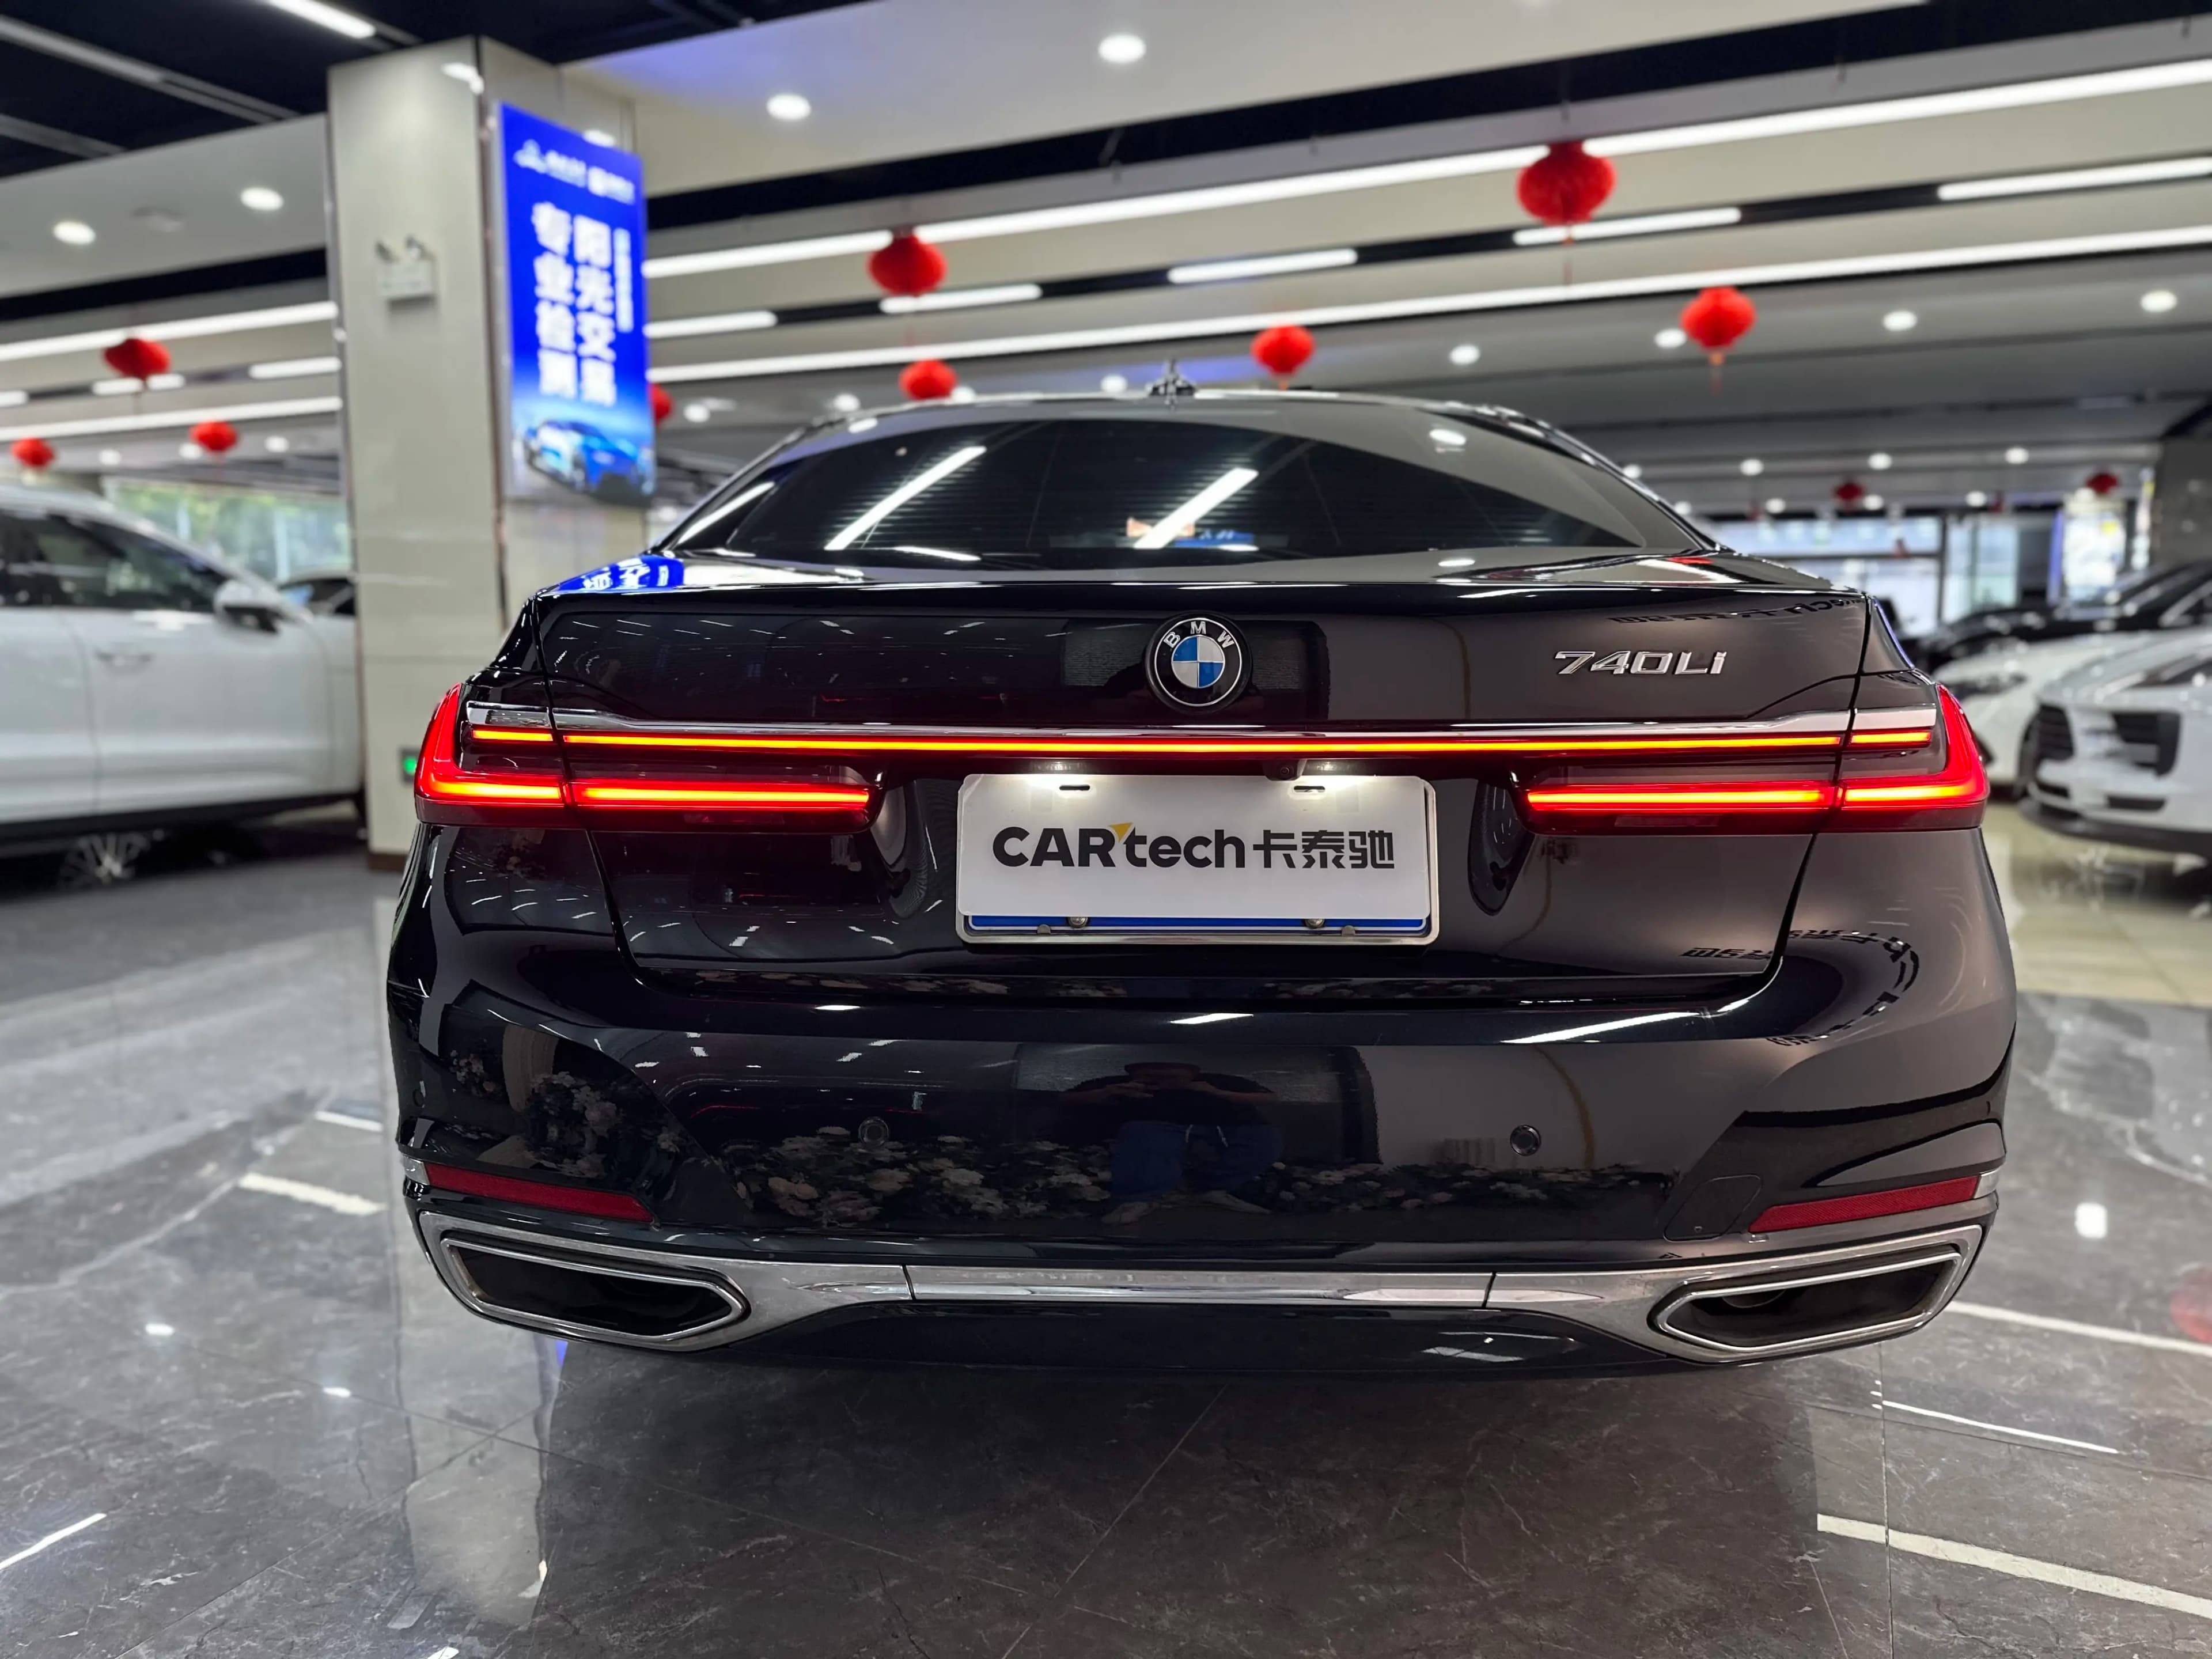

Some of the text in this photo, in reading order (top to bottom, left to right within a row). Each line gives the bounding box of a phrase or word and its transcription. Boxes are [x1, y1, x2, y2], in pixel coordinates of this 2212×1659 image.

[1163, 621, 1234, 649] BMW
[1555, 650, 1727, 675] 740Li
[992, 825, 1395, 870] CARtech 卡泰驰
